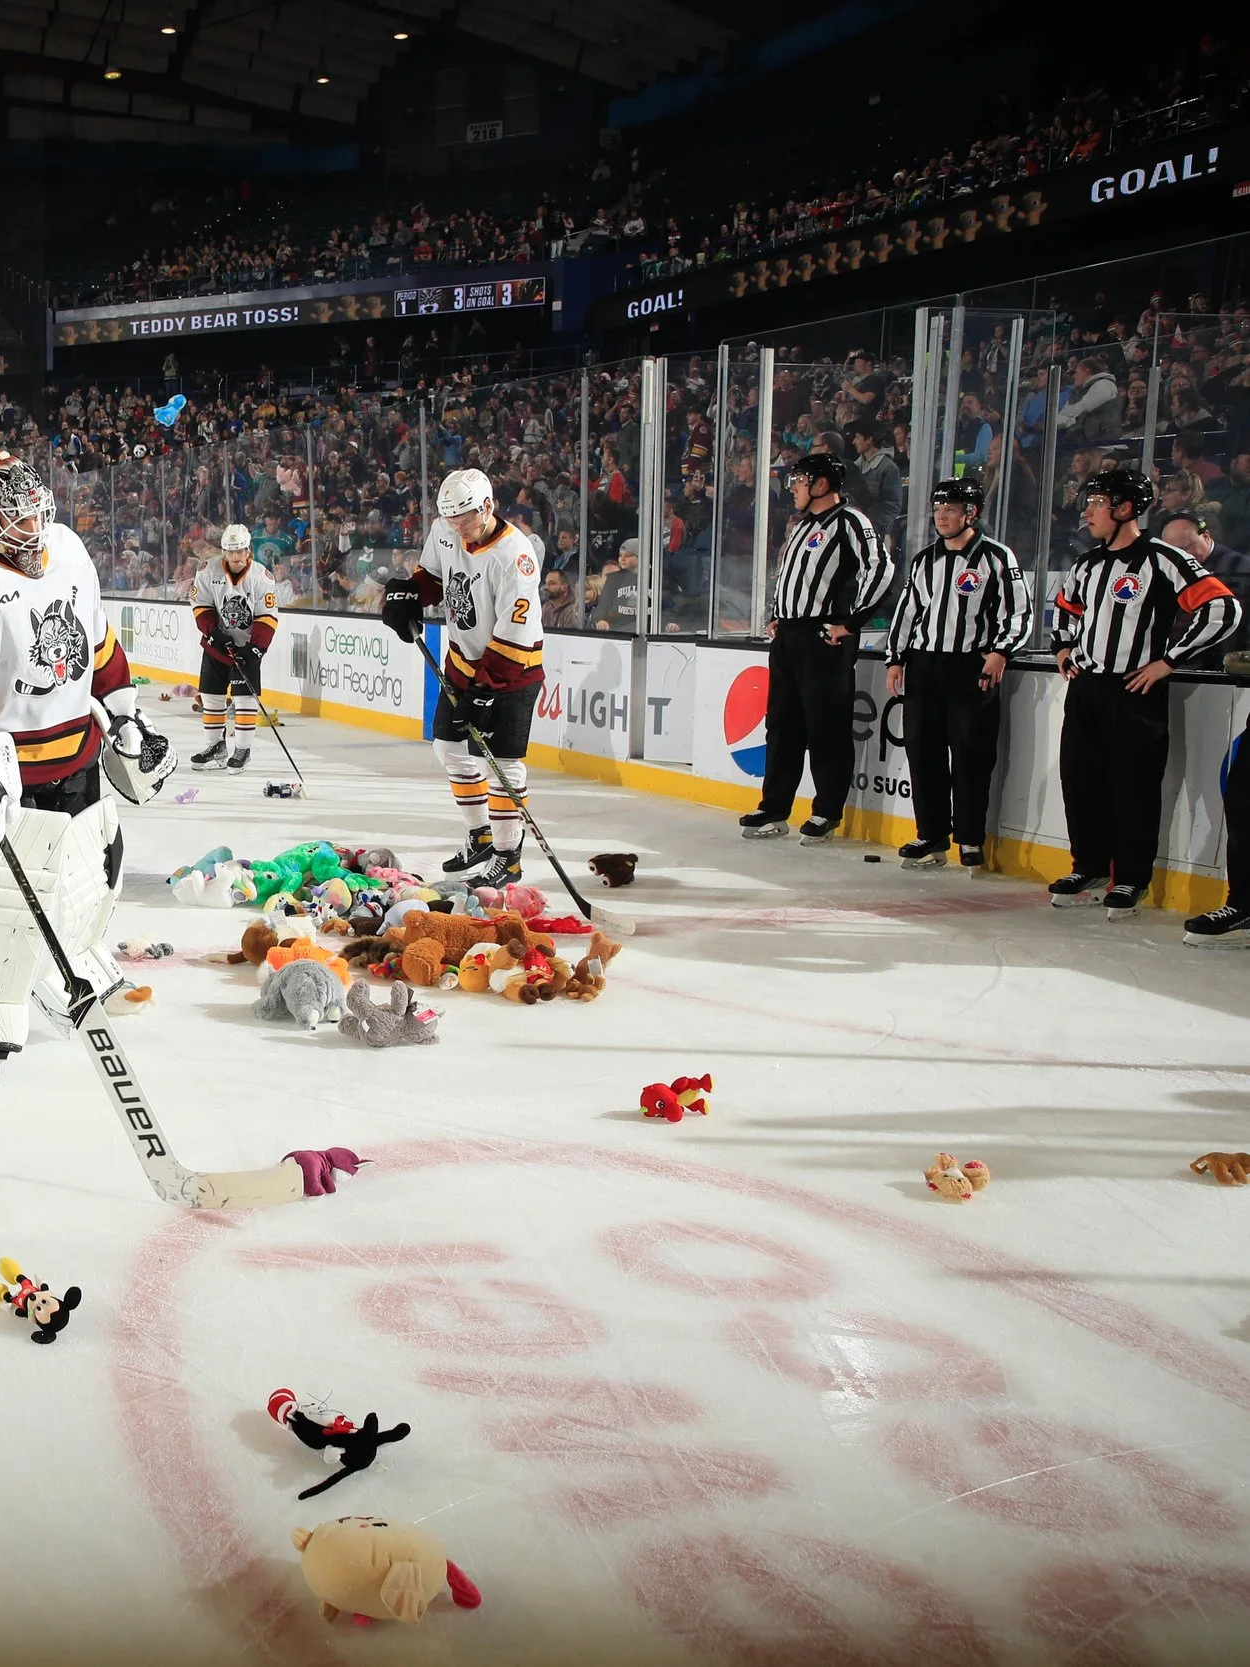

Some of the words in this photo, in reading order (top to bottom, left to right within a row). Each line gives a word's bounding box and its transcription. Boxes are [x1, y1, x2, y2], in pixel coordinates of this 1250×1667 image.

[473, 128, 496, 142] 216
[1091, 147, 1219, 203] GOAL!
[454, 288, 464, 311] 3
[466, 298, 478, 308] ON
[477, 296, 494, 307] GOAL
[469, 285, 492, 298] SHOTS
[502, 283, 512, 306] 3
[627, 289, 683, 318] GOAL!
[130, 317, 186, 335] TEDDY
[191, 312, 238, 330] BEAR
[242, 306, 299, 325] TOSS!
[400, 302, 406, 315] 1
[1010, 568, 1021, 580] 15
[386, 592, 419, 601] CCM
[511, 598, 530, 624] 2
[134, 607, 179, 641] CHICAGO
[325, 626, 389, 666] Greenway
[309, 658, 339, 689] Metal
[343, 664, 402, 707] Recycling
[567, 687, 672, 735] LIGHT
[873, 775, 911, 799] SUG
[86, 1028, 167, 1159] BAUER
